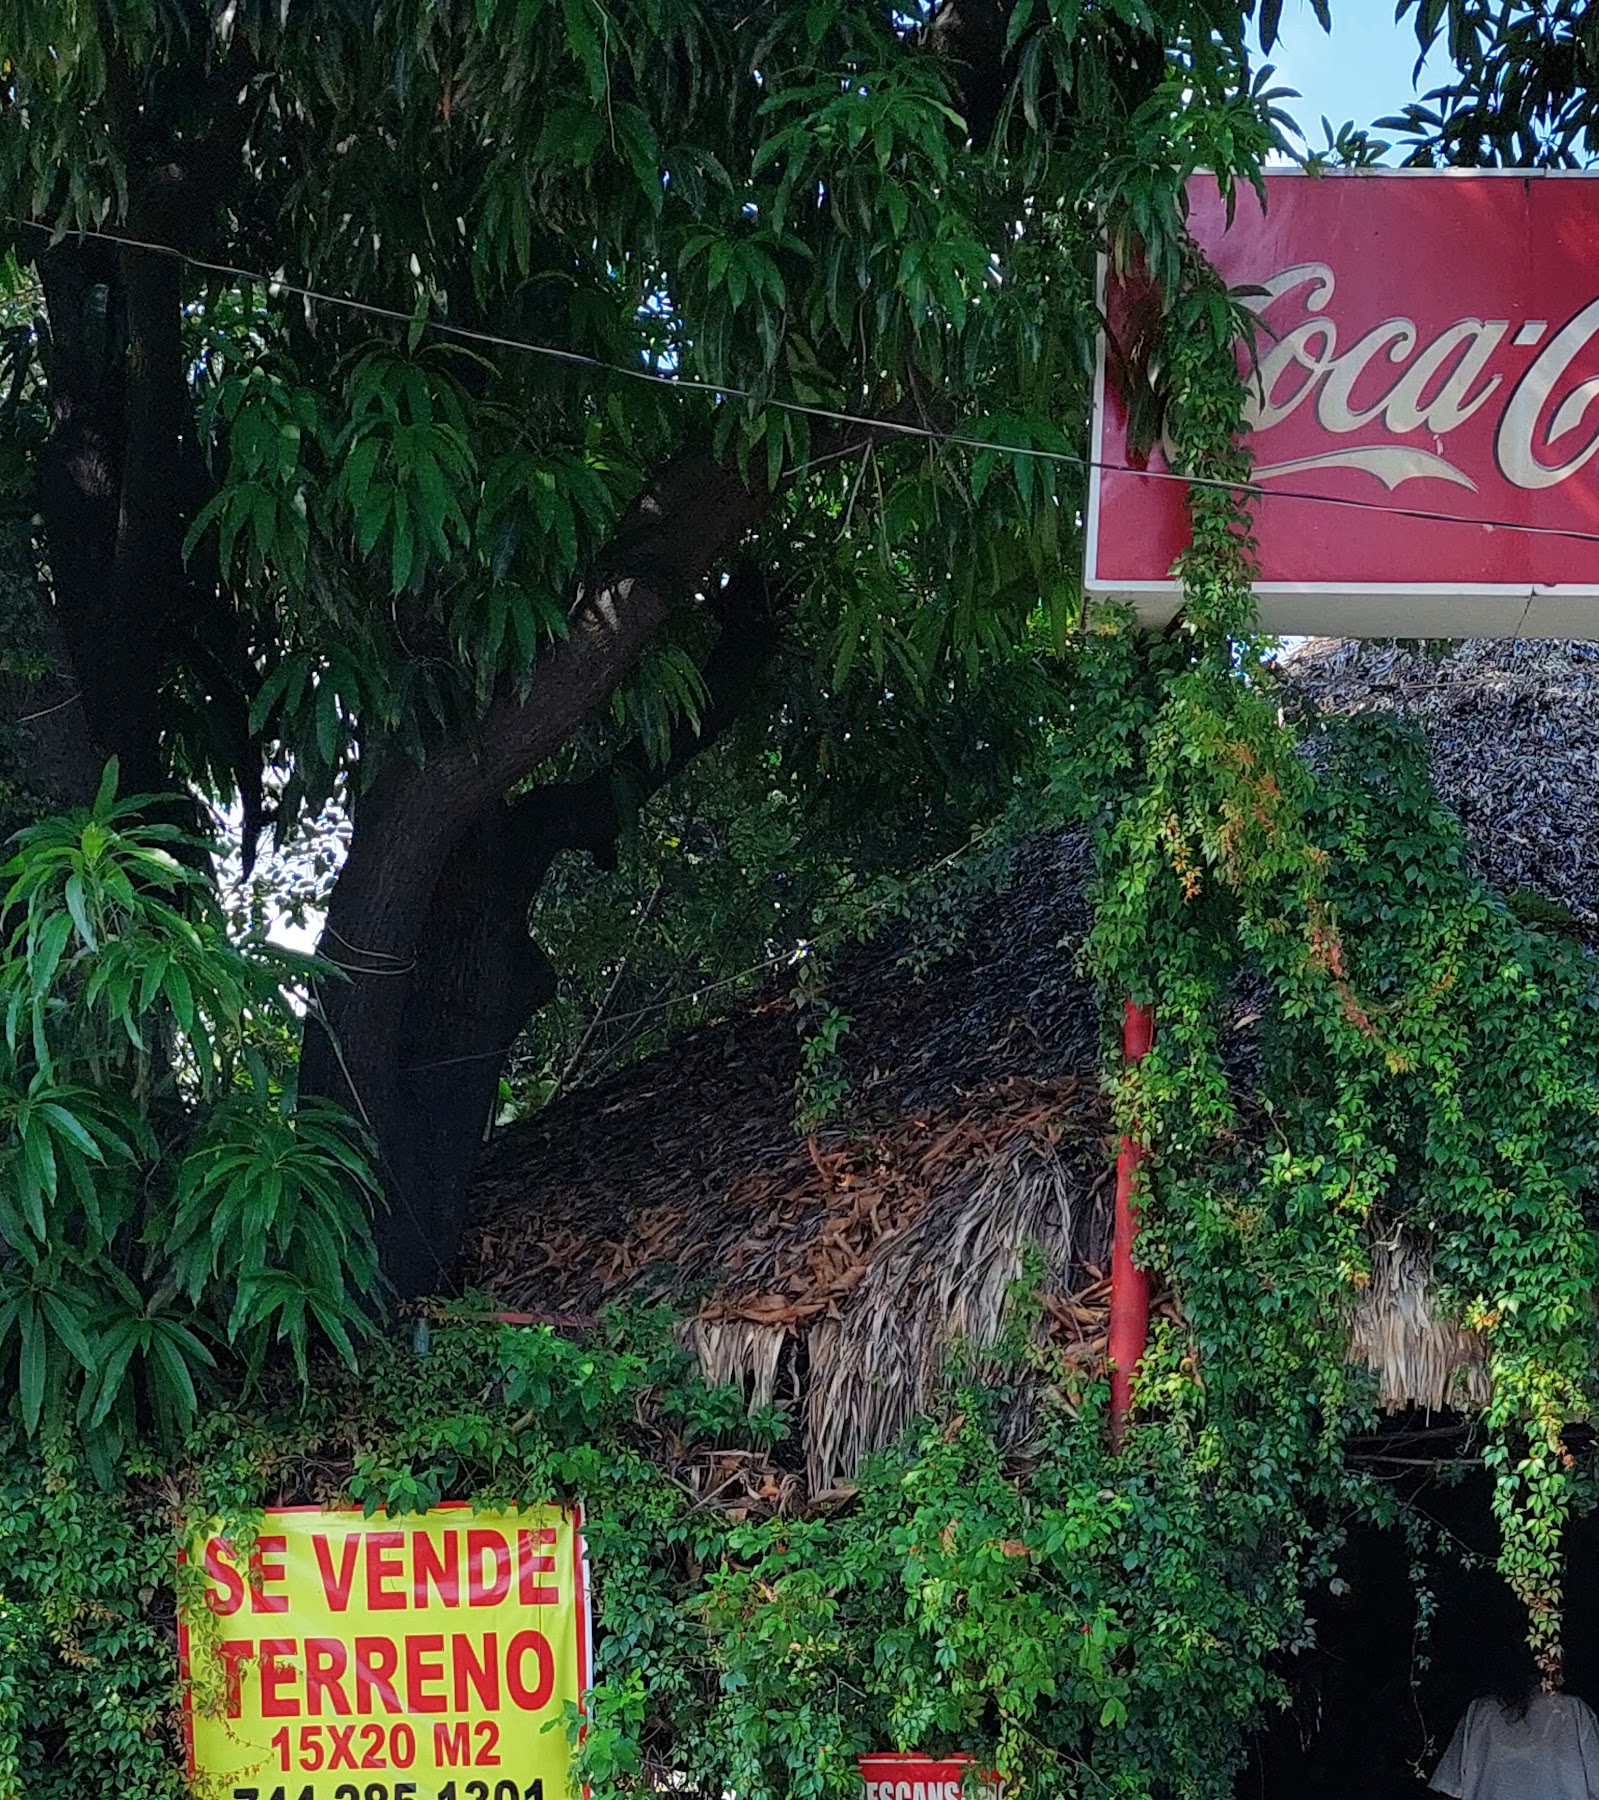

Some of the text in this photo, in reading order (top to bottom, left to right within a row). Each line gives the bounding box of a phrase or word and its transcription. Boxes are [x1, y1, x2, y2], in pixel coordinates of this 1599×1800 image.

[203, 1527, 560, 1616] SE VENDE
[218, 1628, 556, 1720] TERRENO
[271, 1721, 502, 1772] 15X20 M2
